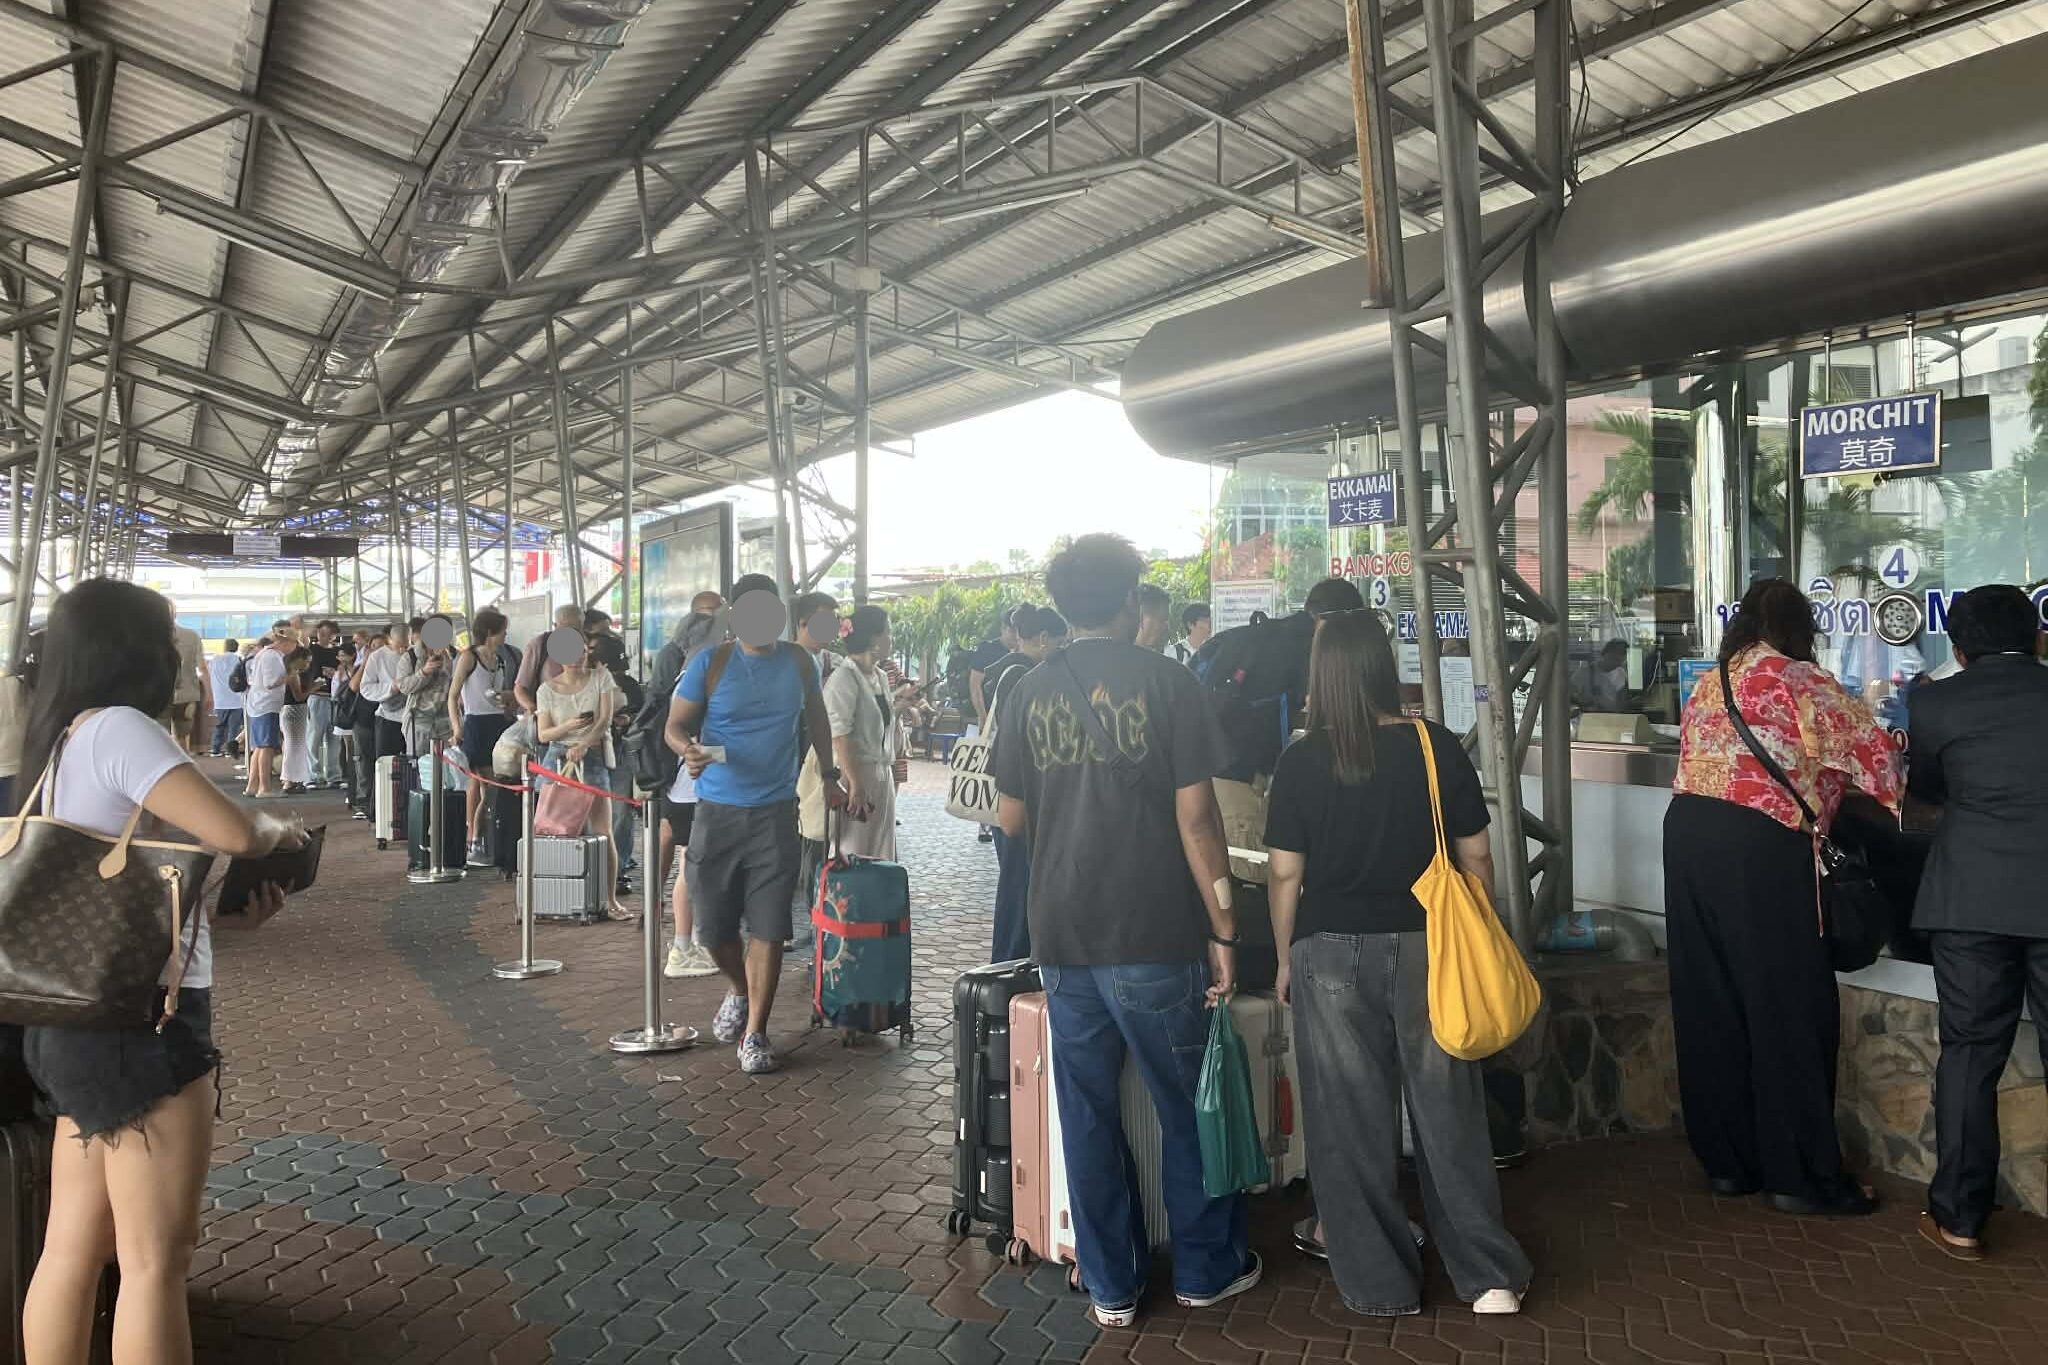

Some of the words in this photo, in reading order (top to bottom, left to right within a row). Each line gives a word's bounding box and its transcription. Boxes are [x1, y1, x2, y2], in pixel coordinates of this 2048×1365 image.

[1807, 398, 1929, 437] MORCHIT
[1839, 435, 1897, 470] 莫奇
[1330, 474, 1391, 500] EKKAMAI
[1338, 498, 1384, 522] 艾卡麦
[1331, 552, 1412, 578] BANGKO
[1883, 548, 1909, 583] 4
[1374, 580, 1387, 606] 3
[1397, 611, 1469, 638] EKAMA
